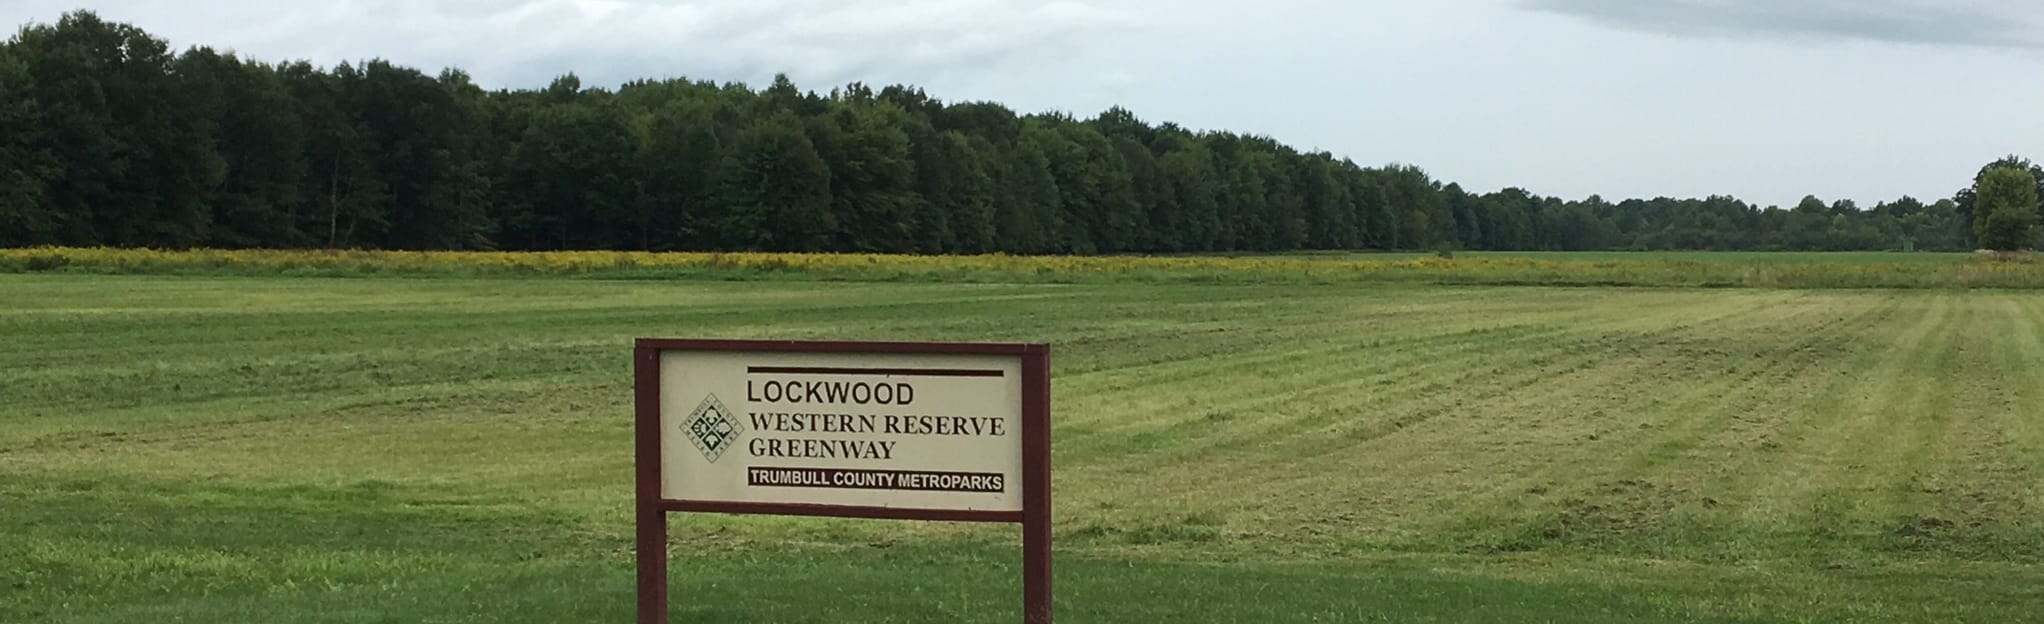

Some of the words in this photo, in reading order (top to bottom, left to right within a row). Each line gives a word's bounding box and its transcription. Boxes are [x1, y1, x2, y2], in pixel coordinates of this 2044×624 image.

[747, 380, 914, 405] LOCKWOOD
[749, 413, 876, 434] WESTERN
[884, 415, 1006, 437] RESERVE
[748, 438, 897, 460] GREENWAY
[751, 470, 830, 486] TRUMBULL
[833, 472, 894, 487] COUNTY
[898, 475, 1003, 491] METROPARKS
